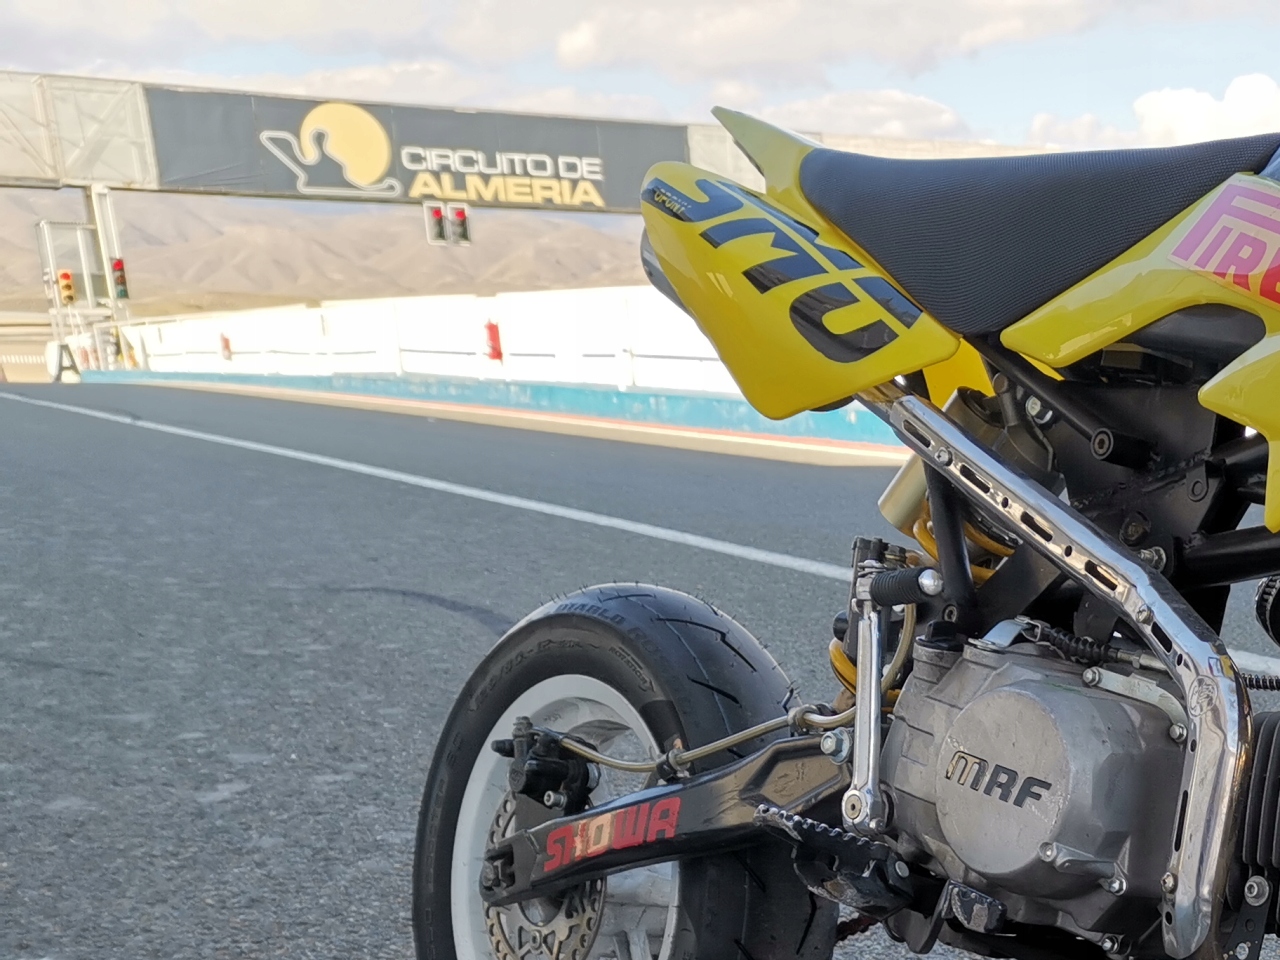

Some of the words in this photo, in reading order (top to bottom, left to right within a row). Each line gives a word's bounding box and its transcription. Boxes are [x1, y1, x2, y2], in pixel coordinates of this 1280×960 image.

[401, 146, 554, 178] CIRCUITO
[558, 155, 604, 181] DE
[408, 170, 606, 208] ALMERIA
[944, 750, 1053, 809] MRF
[543, 796, 682, 873] SHOWA
